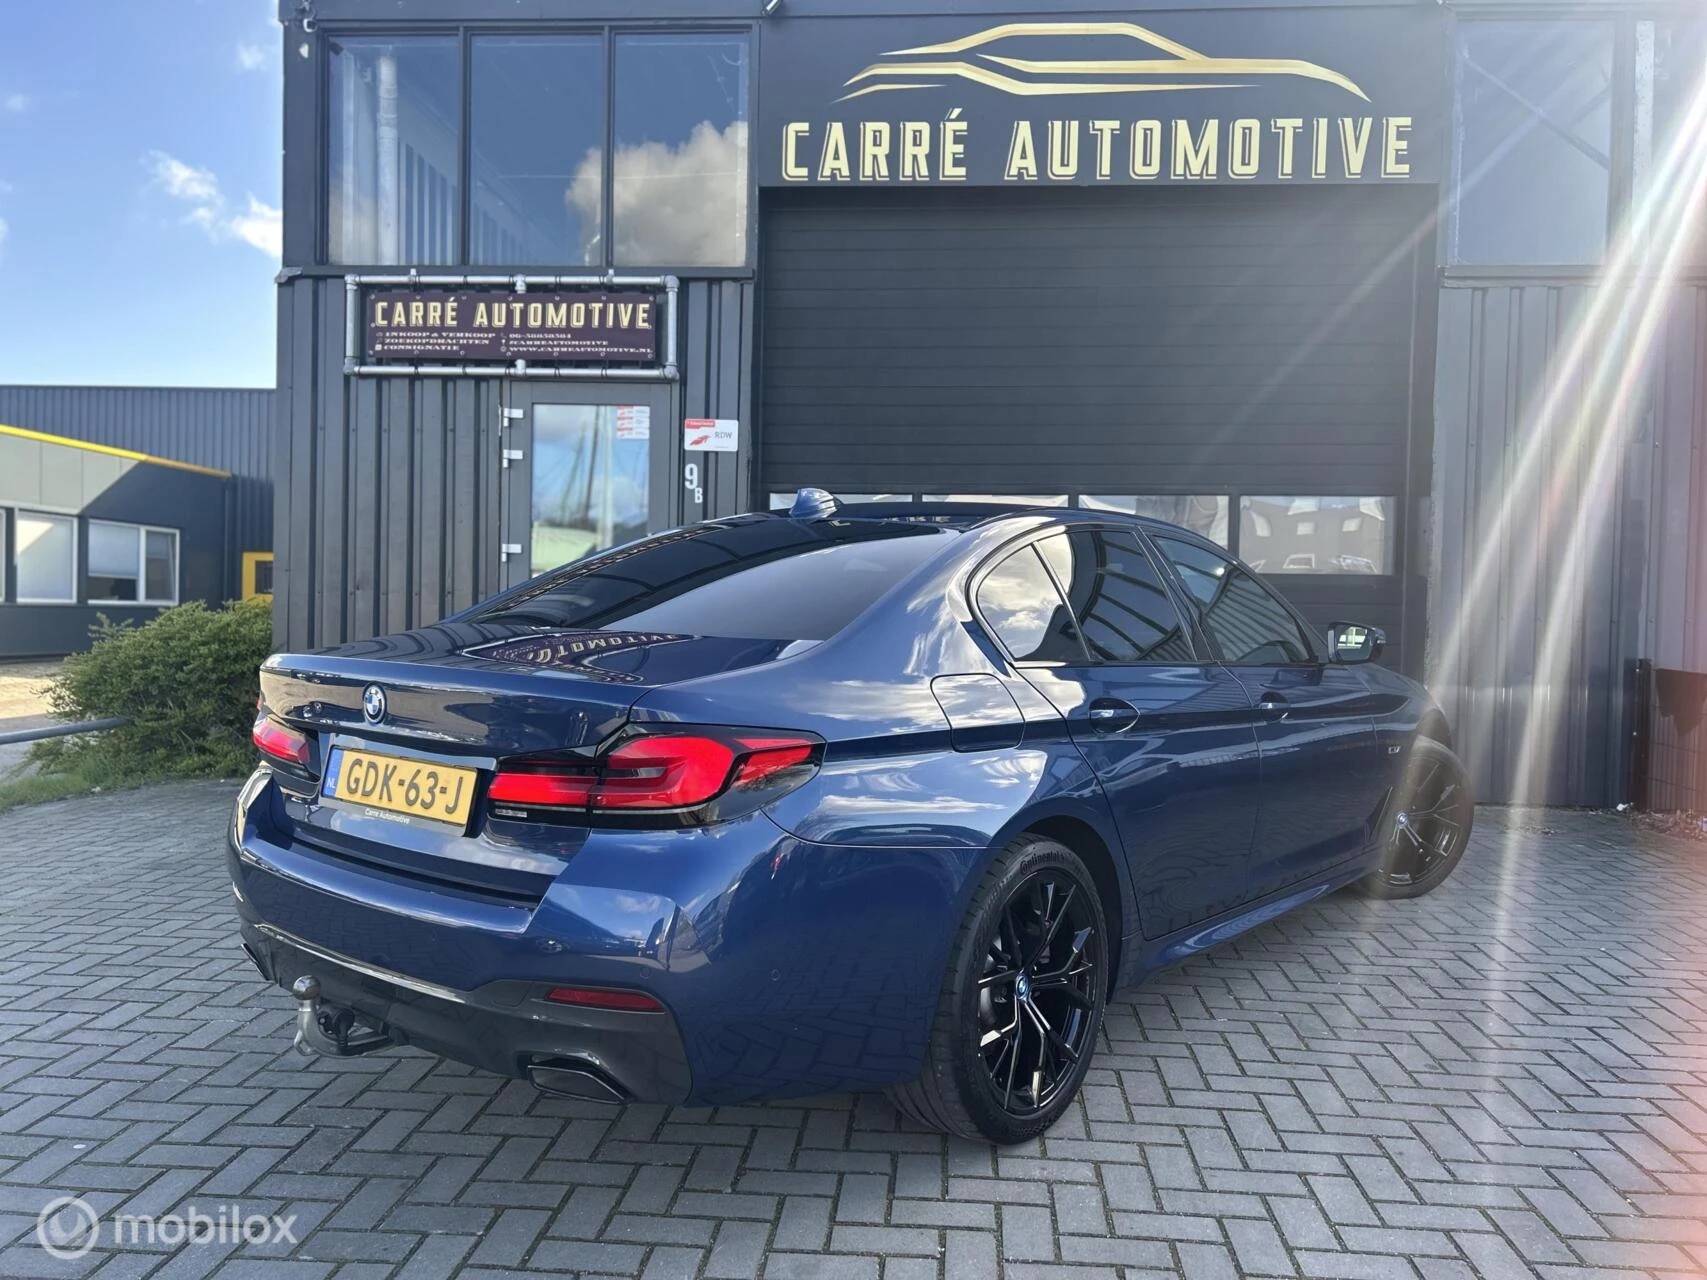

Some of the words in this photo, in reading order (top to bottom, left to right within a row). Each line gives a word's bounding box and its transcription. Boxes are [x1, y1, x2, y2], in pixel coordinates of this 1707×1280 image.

[782, 107, 968, 181] CARRÉ
[1004, 116, 1412, 181] AUTOMOTIVE
[375, 296, 458, 328] CARRÉ
[474, 302, 651, 329] AUTOMOTIVE
[714, 431, 733, 439] RDW
[684, 463, 698, 489] 9
[694, 487, 703, 503] B
[326, 777, 336, 789] NL
[346, 758, 464, 815] GDK-63-J
